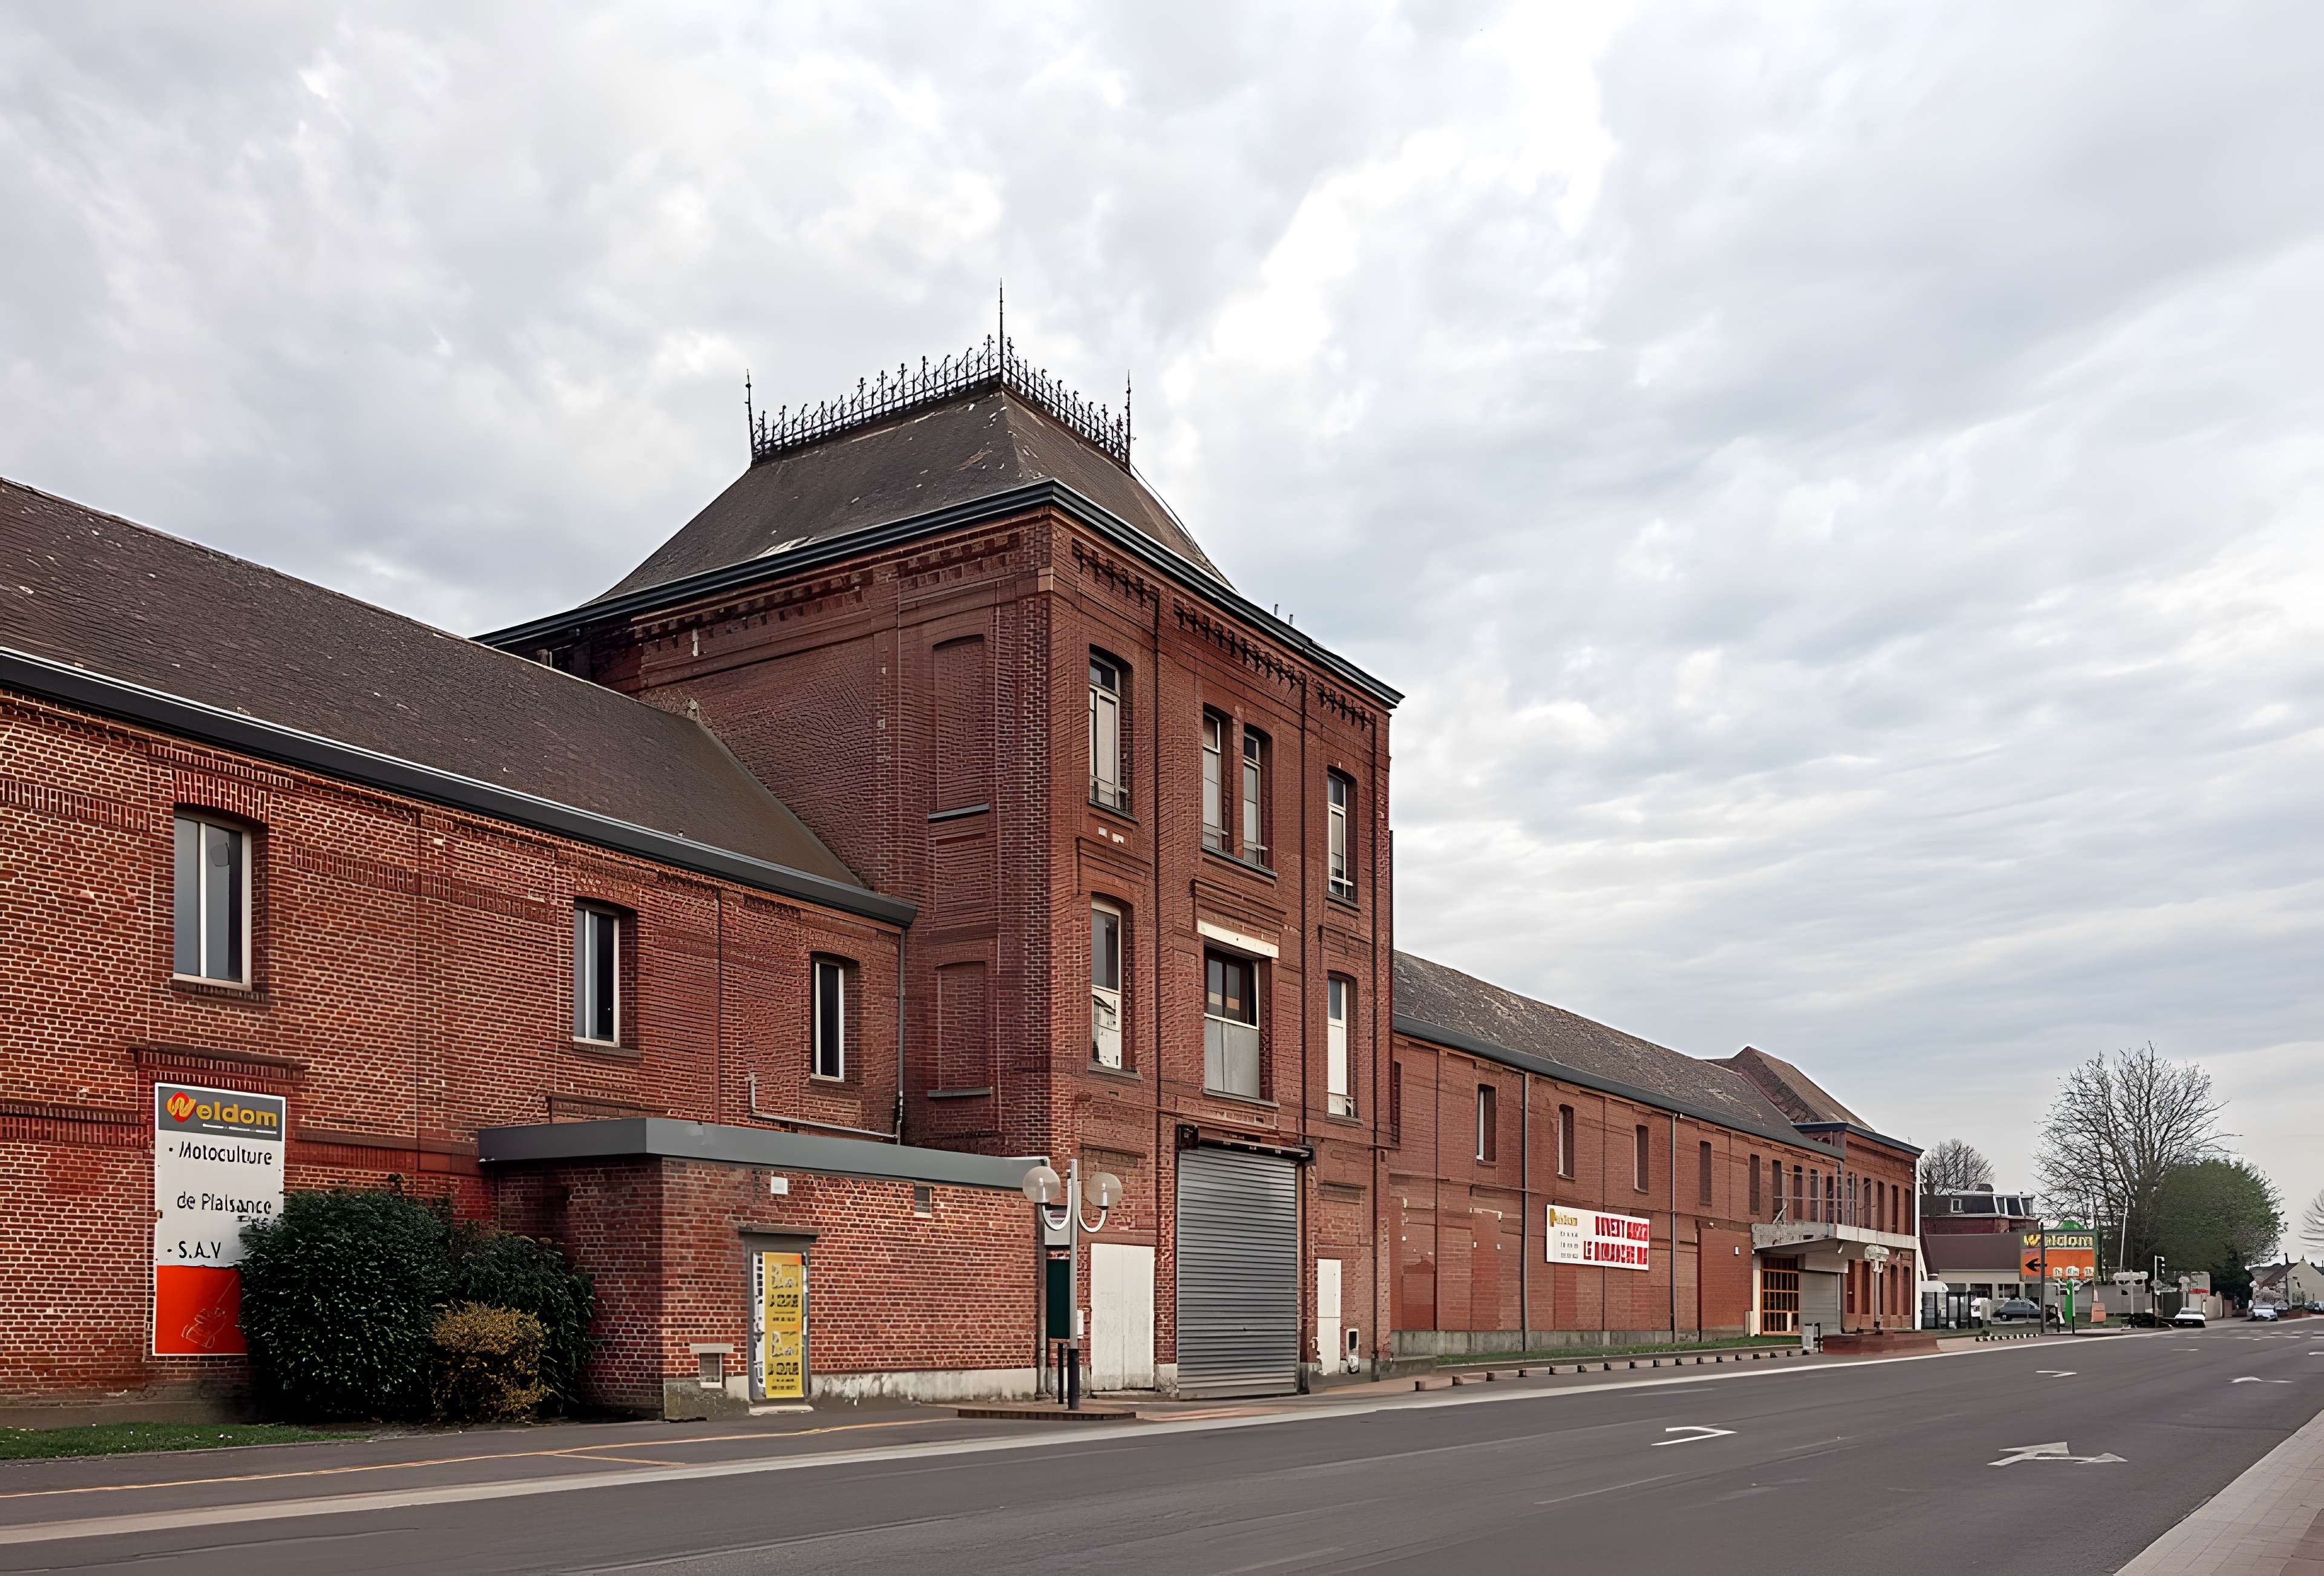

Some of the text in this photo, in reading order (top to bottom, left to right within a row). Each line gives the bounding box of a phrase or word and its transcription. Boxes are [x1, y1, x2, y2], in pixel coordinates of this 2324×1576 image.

[166, 1092, 277, 1127] Weldom
[179, 1141, 272, 1165] Motoculture
[177, 1191, 272, 1215] de Plaisance
